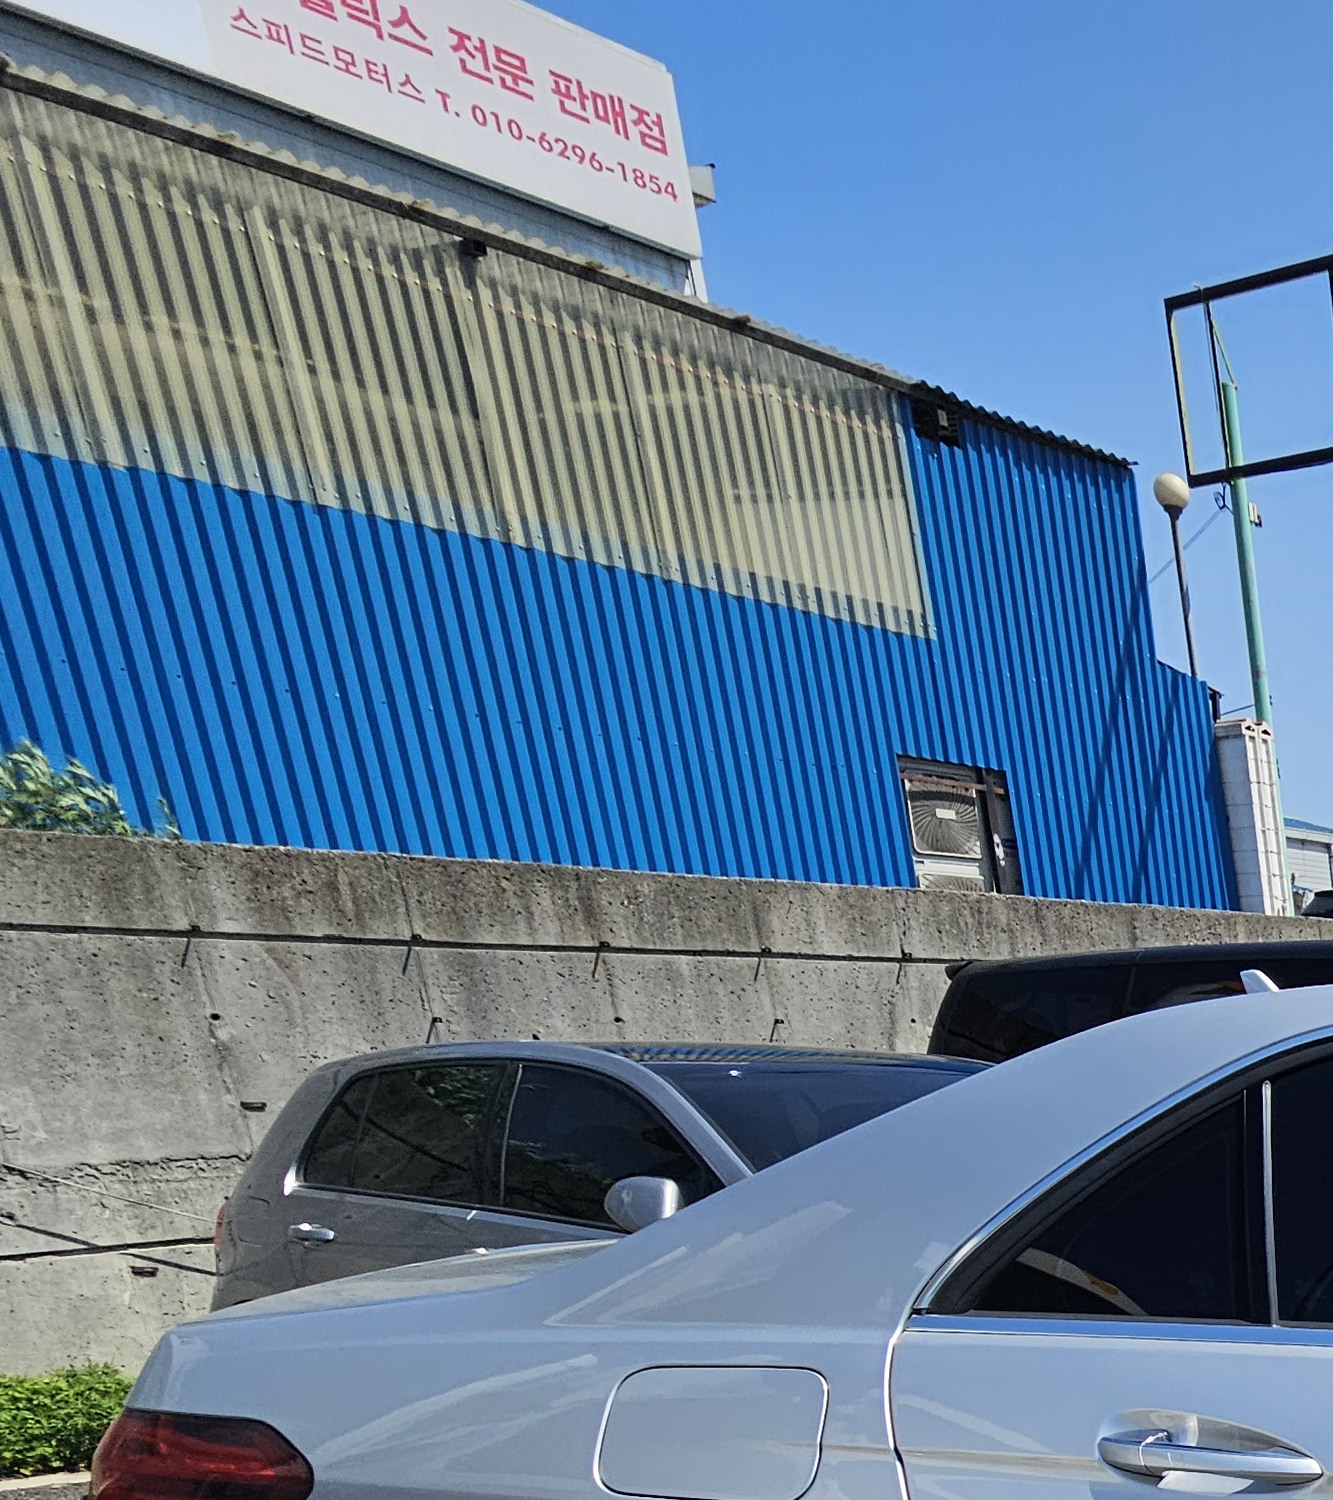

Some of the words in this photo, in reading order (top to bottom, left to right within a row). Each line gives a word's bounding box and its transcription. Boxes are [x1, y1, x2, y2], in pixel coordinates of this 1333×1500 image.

[230, 6, 426, 104] 스피드모터스
[434, 88, 461, 118] T.
[471, 103, 679, 203] 010-6296-1854
[447, 25, 535, 102] 전문
[548, 68, 669, 157] 판매점
